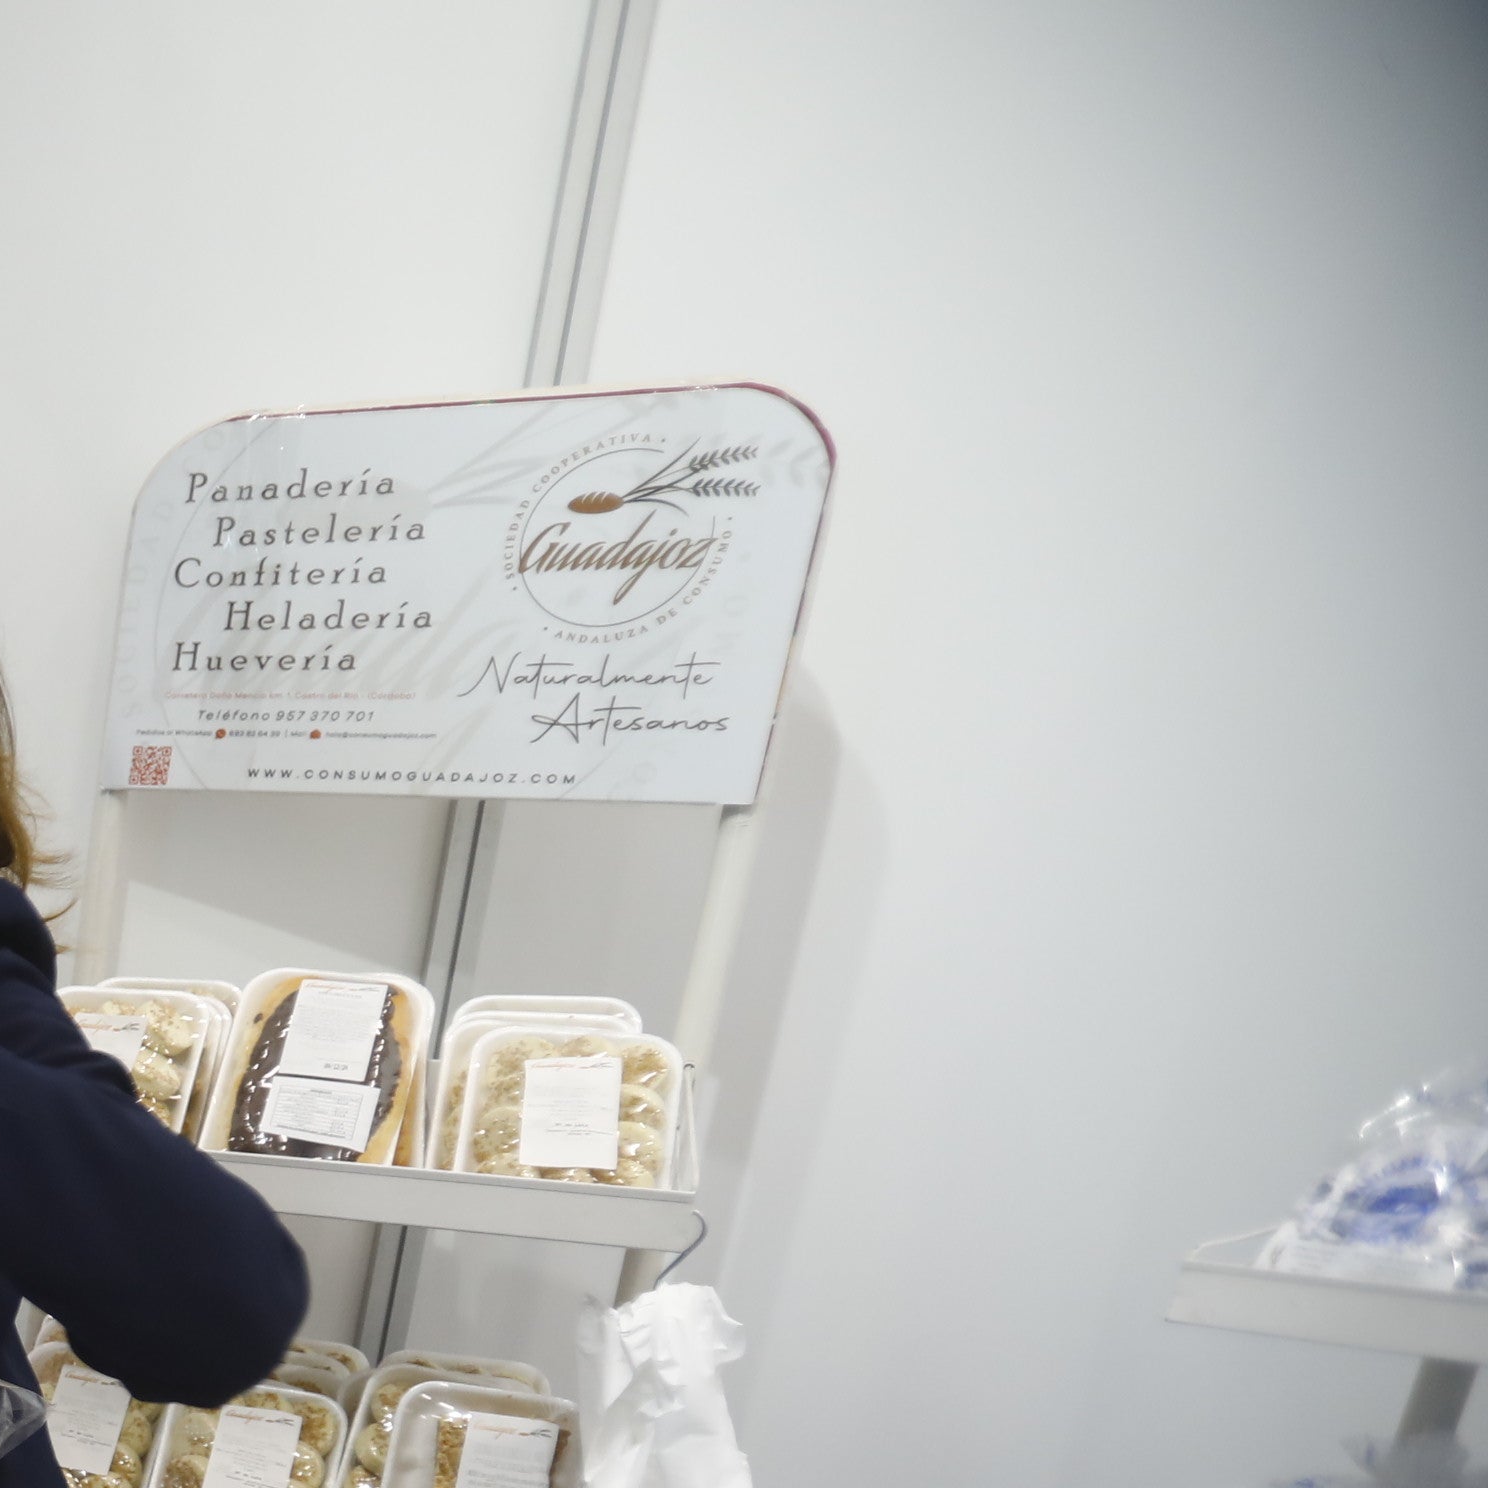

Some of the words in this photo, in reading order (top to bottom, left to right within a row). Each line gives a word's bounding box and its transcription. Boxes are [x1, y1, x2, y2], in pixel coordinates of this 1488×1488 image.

[185, 468, 395, 503] Panadería
[504, 499, 530, 580] SOCIEDAD
[532, 433, 652, 493] COOPERATIVA
[213, 513, 426, 547] Pastelería
[174, 556, 387, 588] Confitería
[518, 509, 719, 605] Guadajoz
[554, 625, 649, 644] ANDALUZA
[656, 609, 678, 626] DE
[682, 529, 734, 605] CONSUMO
[224, 599, 432, 631] Heladería
[173, 641, 357, 671] Huevería
[457, 652, 721, 699] Naturalmente
[198, 709, 270, 721] Teléfono
[275, 710, 305, 721] 957
[309, 710, 340, 722] 370
[345, 711, 375, 722] 701
[530, 692, 730, 746] Artesanos
[247, 767, 577, 784] WWW.CONSUMOGUADAJOZ.COM
